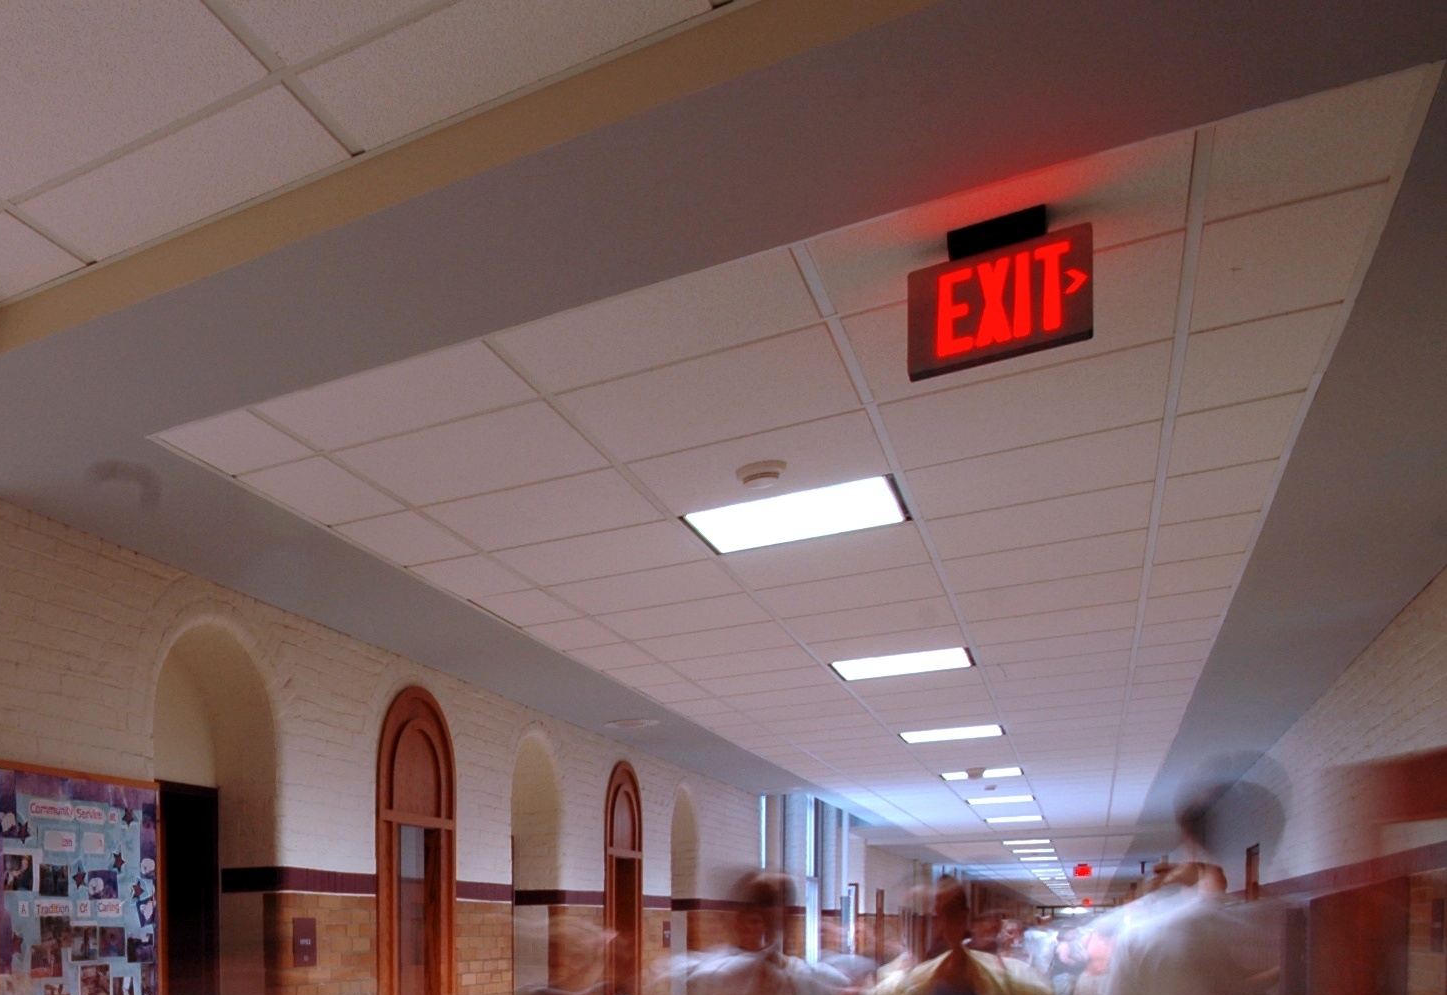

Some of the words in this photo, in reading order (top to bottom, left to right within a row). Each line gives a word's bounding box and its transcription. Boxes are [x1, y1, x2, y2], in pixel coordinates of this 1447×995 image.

[937, 241, 1070, 358] EXIT
[21, 905, 27, 915] A
[36, 904, 70, 914] Tradition
